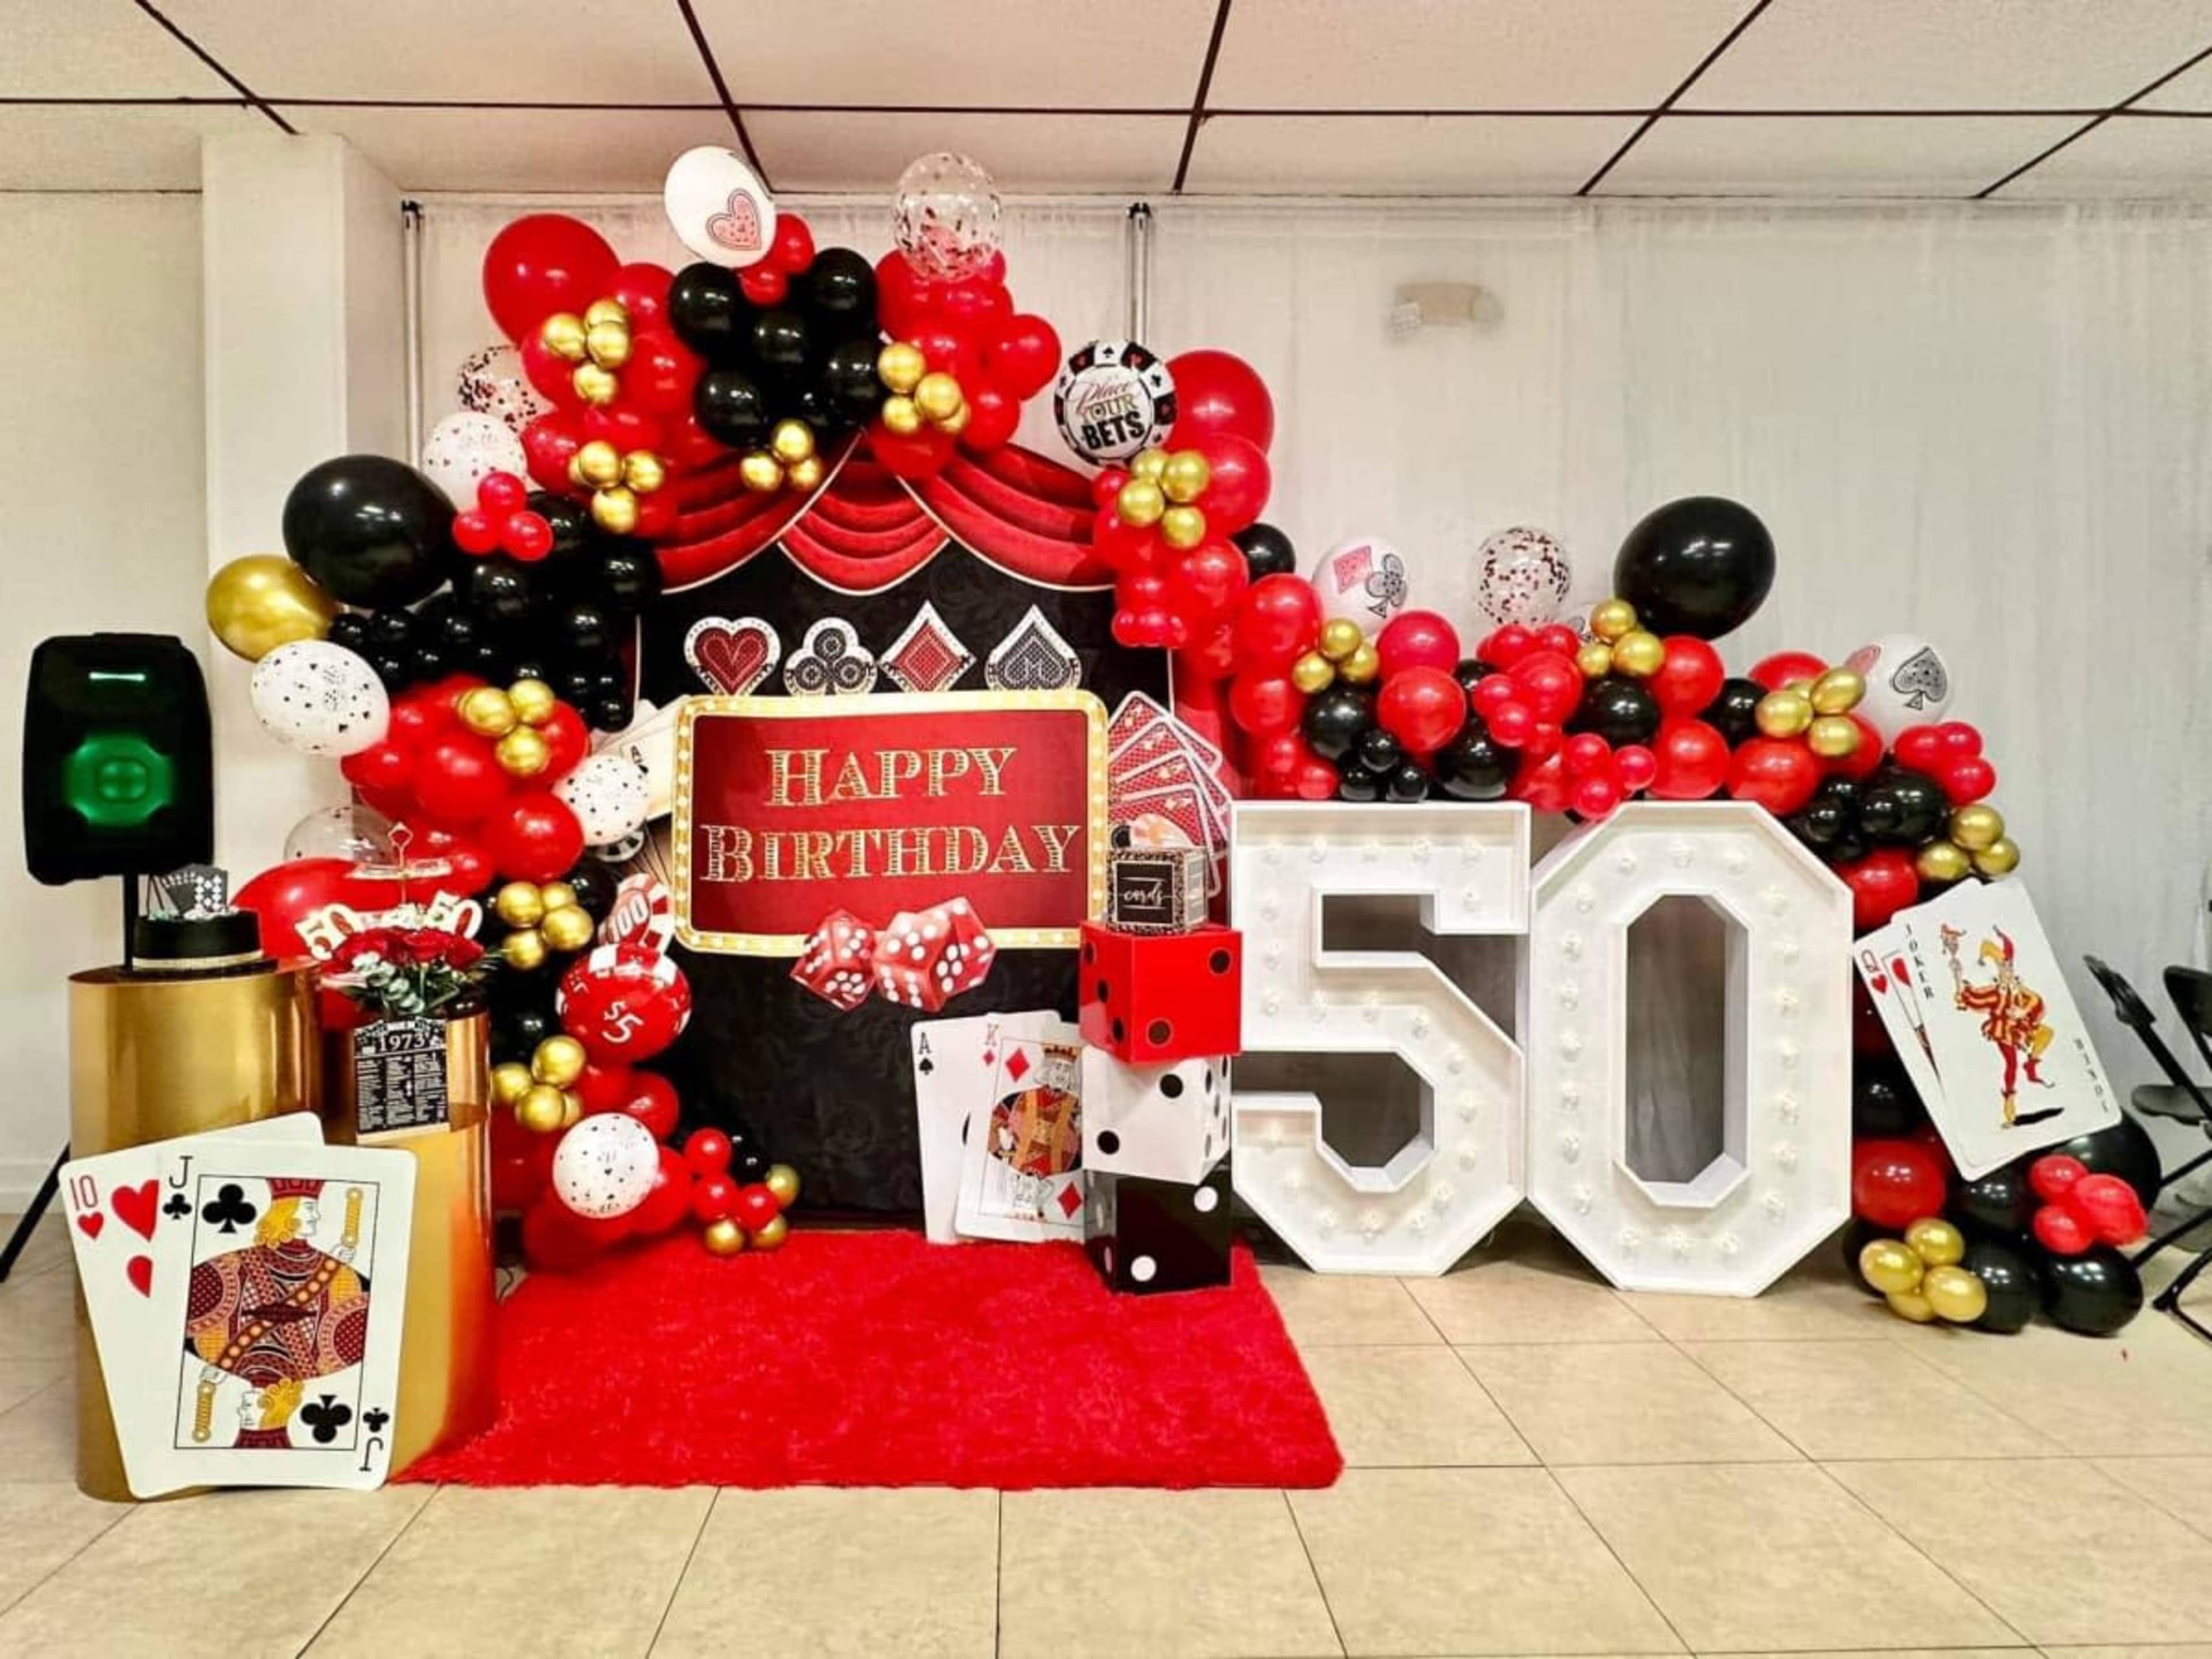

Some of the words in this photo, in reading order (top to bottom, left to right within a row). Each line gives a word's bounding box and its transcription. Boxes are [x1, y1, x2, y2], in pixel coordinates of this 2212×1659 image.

[1082, 393, 1138, 424] YOUR
[1082, 411, 1145, 450] BETS
[766, 748, 1017, 806] HAPPY
[700, 824, 1081, 882] BIRTHDAY
[1861, 949, 1881, 974] Q
[378, 1032, 425, 1052] 1973
[919, 1032, 931, 1055] A
[1231, 801, 1853, 1298] 50
[169, 1154, 193, 1189] J
[70, 1174, 99, 1211] 10
[359, 1437, 384, 1471] J
